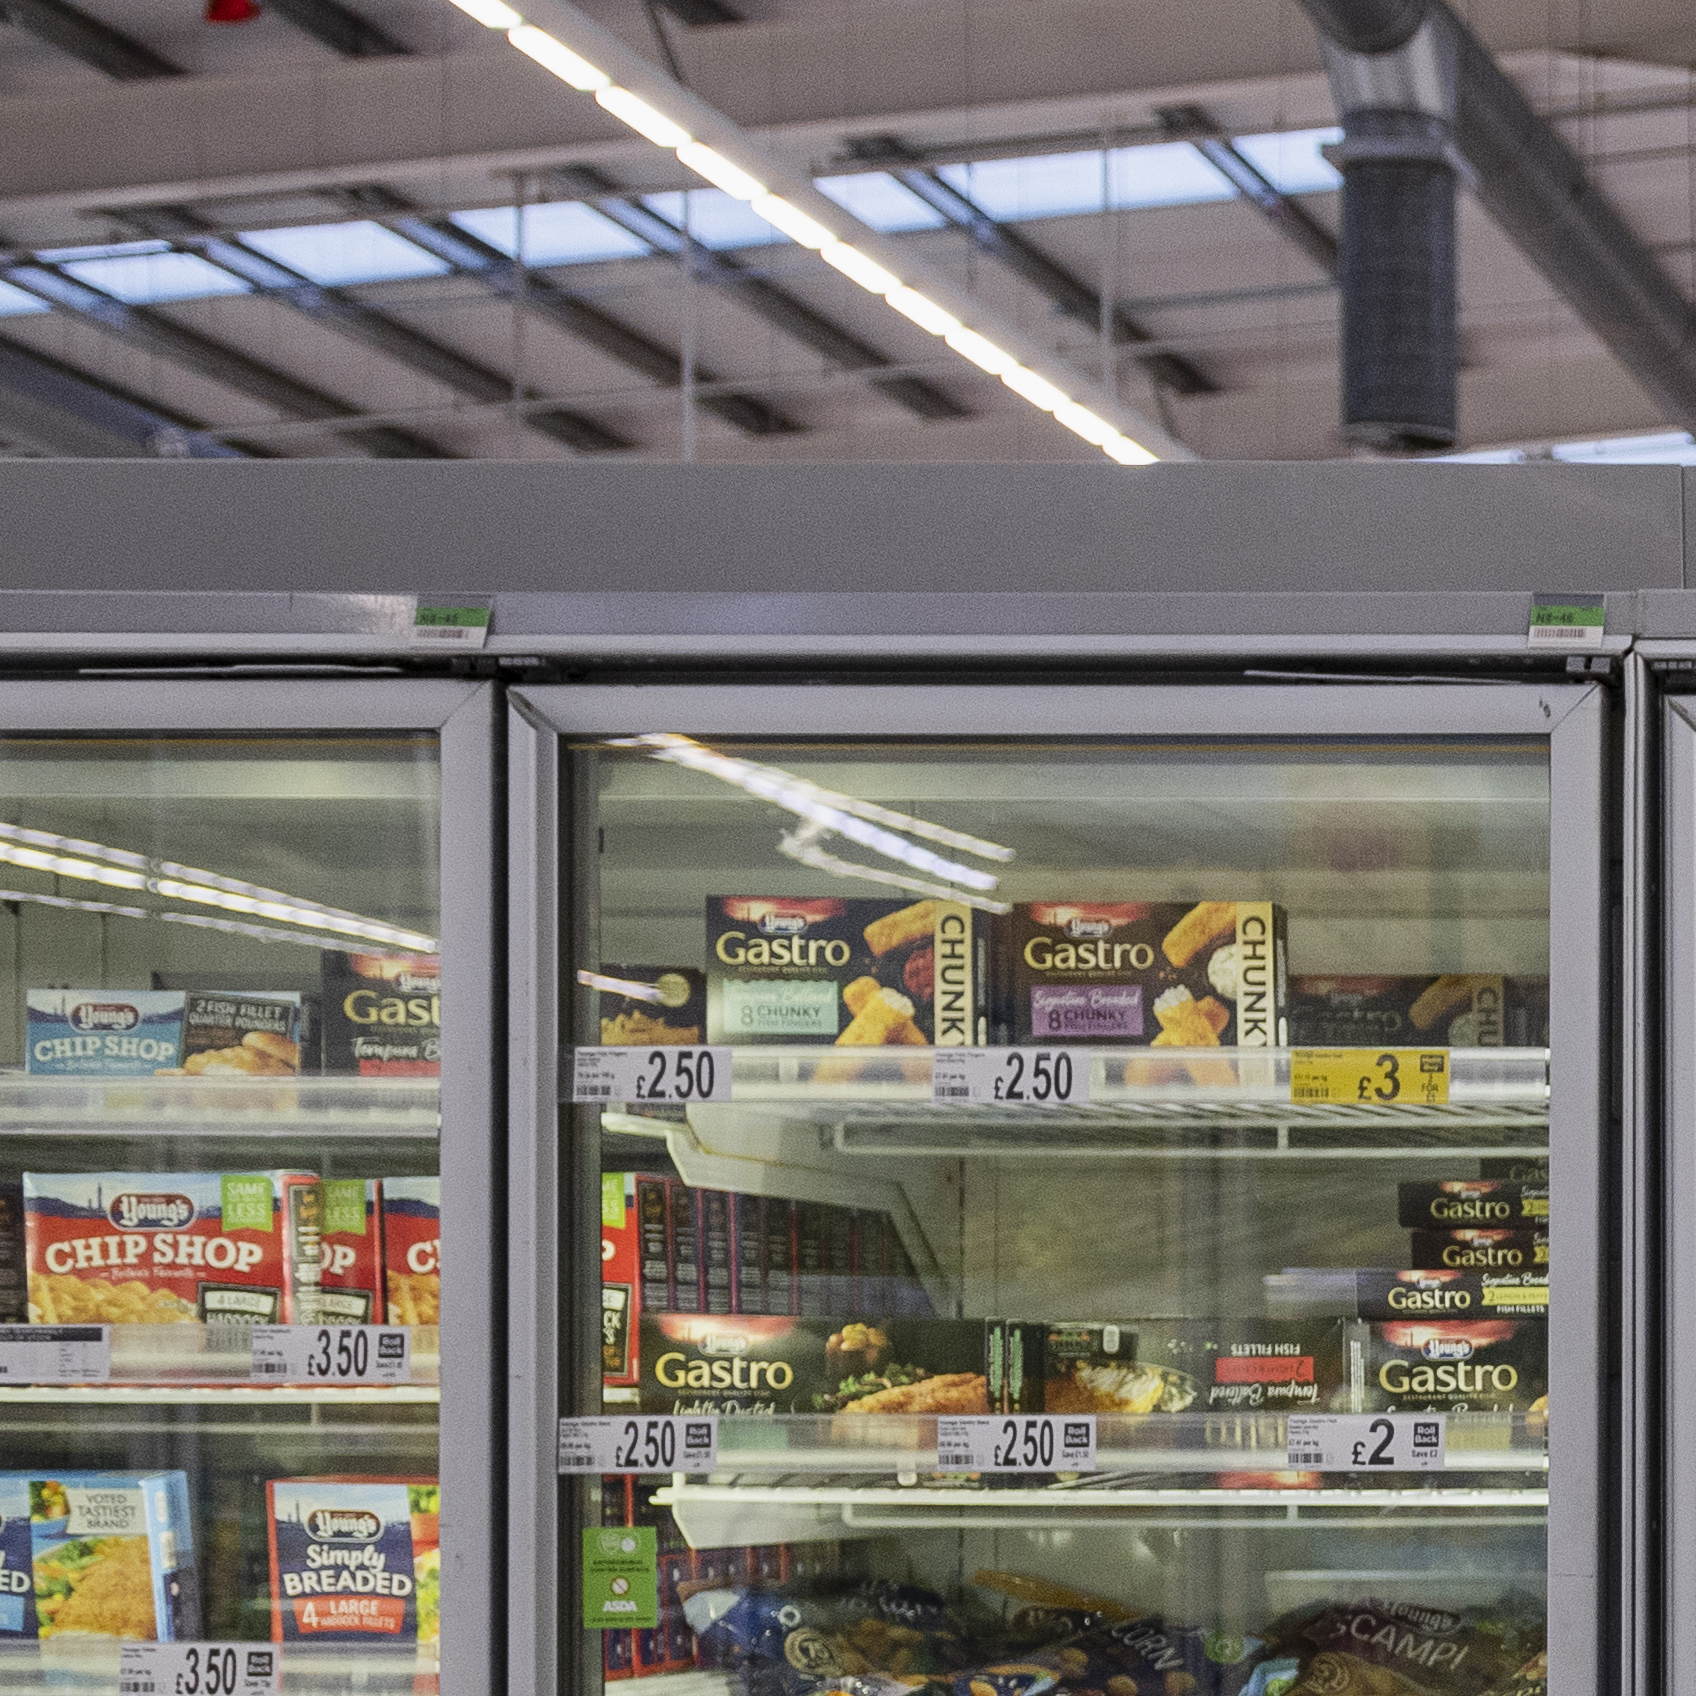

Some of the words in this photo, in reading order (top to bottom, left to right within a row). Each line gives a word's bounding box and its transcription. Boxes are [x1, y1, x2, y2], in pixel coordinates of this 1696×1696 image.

[715, 932, 851, 967] Gastro
[1024, 937, 1154, 970] Gastro
[35, 1037, 101, 1060] CHIP
[105, 1036, 175, 1061] SHOP
[636, 1051, 714, 1099] £2.50
[994, 1052, 1072, 1101] £2.50
[1357, 1055, 1400, 1100] £3
[120, 1197, 188, 1226] Young's
[1430, 1198, 1510, 1219] Gastro
[46, 1237, 144, 1273] CHIP
[153, 1235, 262, 1272] SHOP
[1443, 1246, 1522, 1267] Gastro
[1388, 1287, 1470, 1310] Gastro
[308, 1330, 368, 1376] £3.50
[654, 1352, 794, 1390] Gastro
[1379, 1361, 1518, 1394] Gastro
[615, 1421, 675, 1468] £2.50
[994, 1421, 1053, 1466] £2.50
[1351, 1420, 1395, 1465] £2
[1414, 1435, 1438, 1446] Back
[1415, 1426, 1437, 1435] Roll
[315, 1512, 376, 1538] Young's
[306, 1544, 386, 1572] Simply
[282, 1569, 412, 1596] BREADED
[303, 1601, 319, 1628] 4
[330, 1600, 379, 1615] LARGE
[175, 1648, 236, 1695] £3.50
